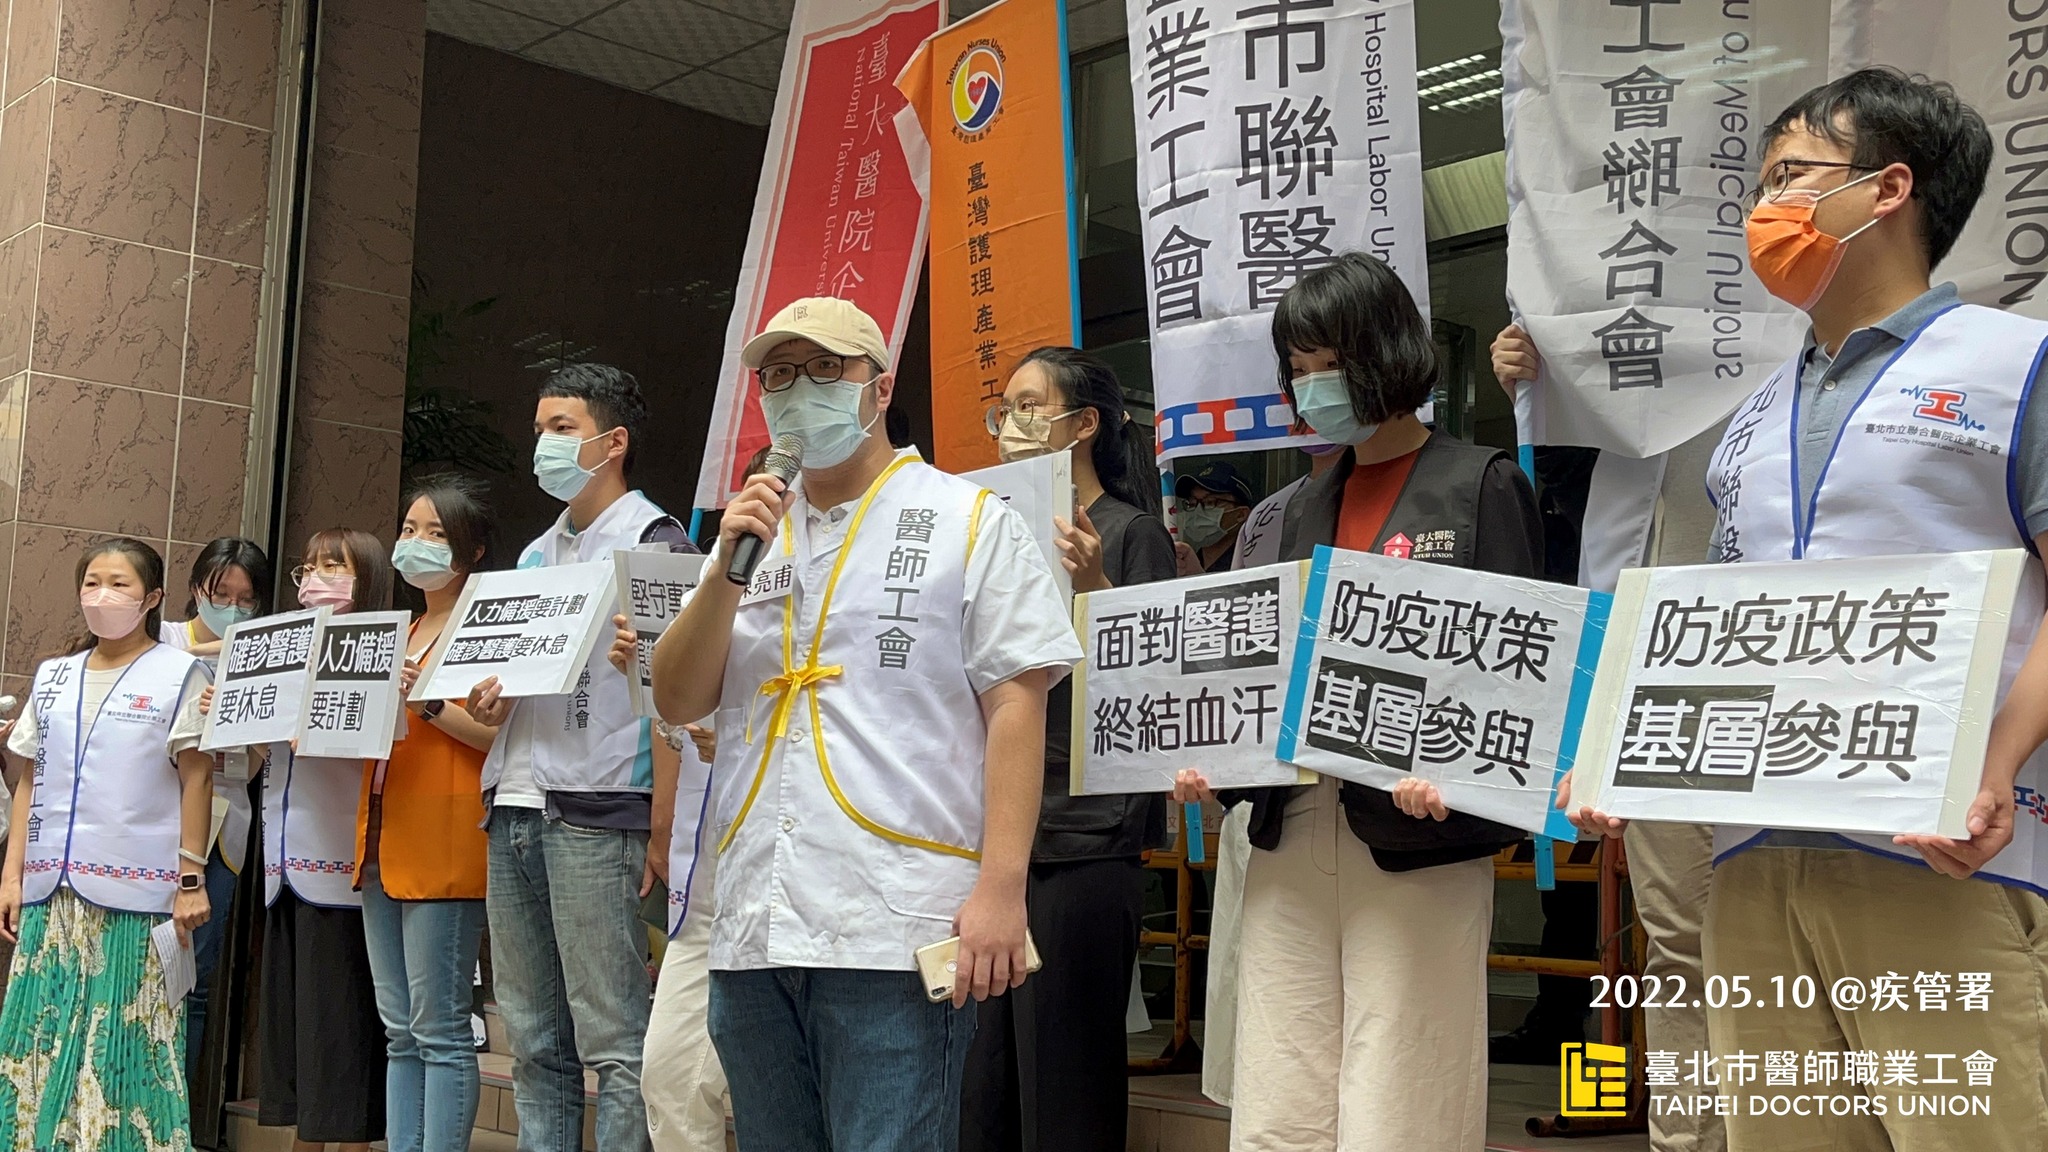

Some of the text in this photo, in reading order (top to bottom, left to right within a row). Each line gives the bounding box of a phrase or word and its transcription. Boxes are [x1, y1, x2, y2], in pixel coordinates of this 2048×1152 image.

[843, 47, 866, 129] National
[946, 38, 1007, 86] Taiwan Nurses Union
[828, 137, 855, 207] Taiwan
[1146, 0, 1211, 329] 業工會
[1361, 12, 1397, 272] Hospital Labor Un
[1999, 117, 2048, 305] UNION
[967, 161, 1003, 441] 臺灣護理產業工
[1864, 423, 2002, 456] 臺北市立聯合醫院企業工會
[1882, 436, 1975, 458] Taipei City Hospital Labor Union
[1414, 540, 1455, 553] 企業工會
[1415, 530, 1456, 543] 臺大醫院
[1432, 551, 1454, 559] UNION
[464, 593, 589, 626] 人力備援要計劃
[631, 578, 698, 619] 堅守專
[875, 508, 936, 670] 醫師工會
[227, 623, 313, 676] 確診醫護
[318, 630, 392, 675] 人力備援
[446, 633, 569, 663] 確診醫護要休息
[1096, 590, 1280, 671] 面對醫護
[1328, 580, 1558, 683] 防疫政策
[1644, 586, 1950, 669] 防疫政策
[216, 682, 277, 727] 要休息
[308, 690, 367, 732] 要計劃
[575, 661, 591, 729] 聯合會
[1093, 683, 1278, 757] 終結血汗
[1309, 670, 1534, 787] 基層參與
[1619, 698, 1919, 783] 基層參與
